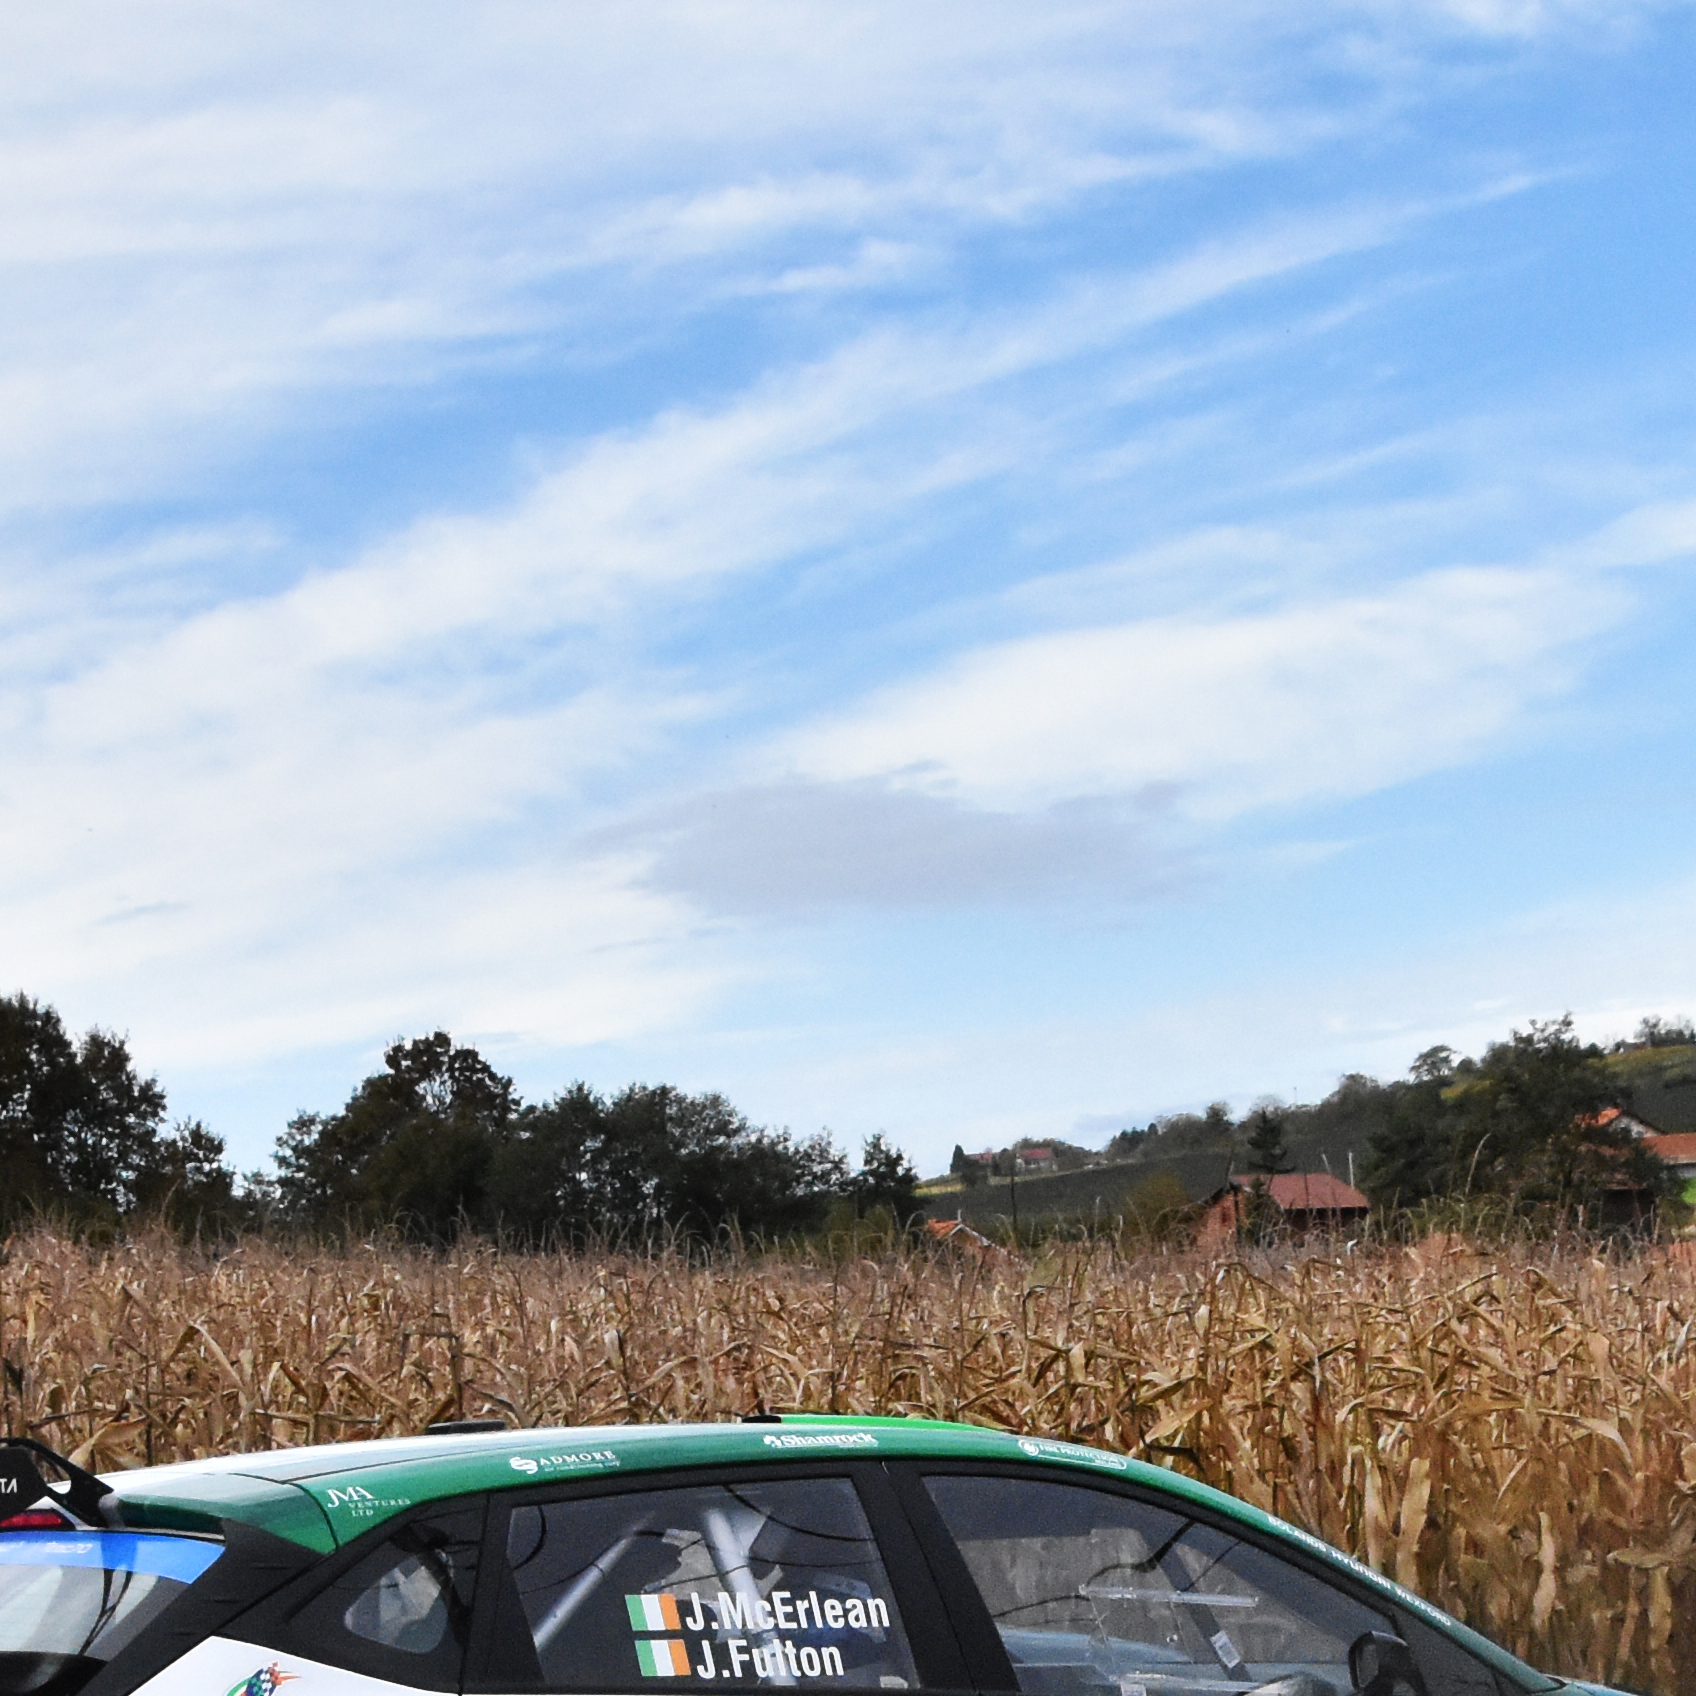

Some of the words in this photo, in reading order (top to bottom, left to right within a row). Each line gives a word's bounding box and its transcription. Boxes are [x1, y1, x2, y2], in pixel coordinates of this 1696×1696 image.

[780, 1433, 877, 1447] Shamrock
[540, 1450, 616, 1466] ADMORE
[327, 1486, 375, 1508] JMA
[348, 1499, 411, 1508] VENTURES
[351, 1509, 374, 1517] LTD
[685, 1591, 890, 1631] J.McErlean
[1394, 1586, 1452, 1625] WEXFORD
[696, 1639, 845, 1679] J.Fulton
